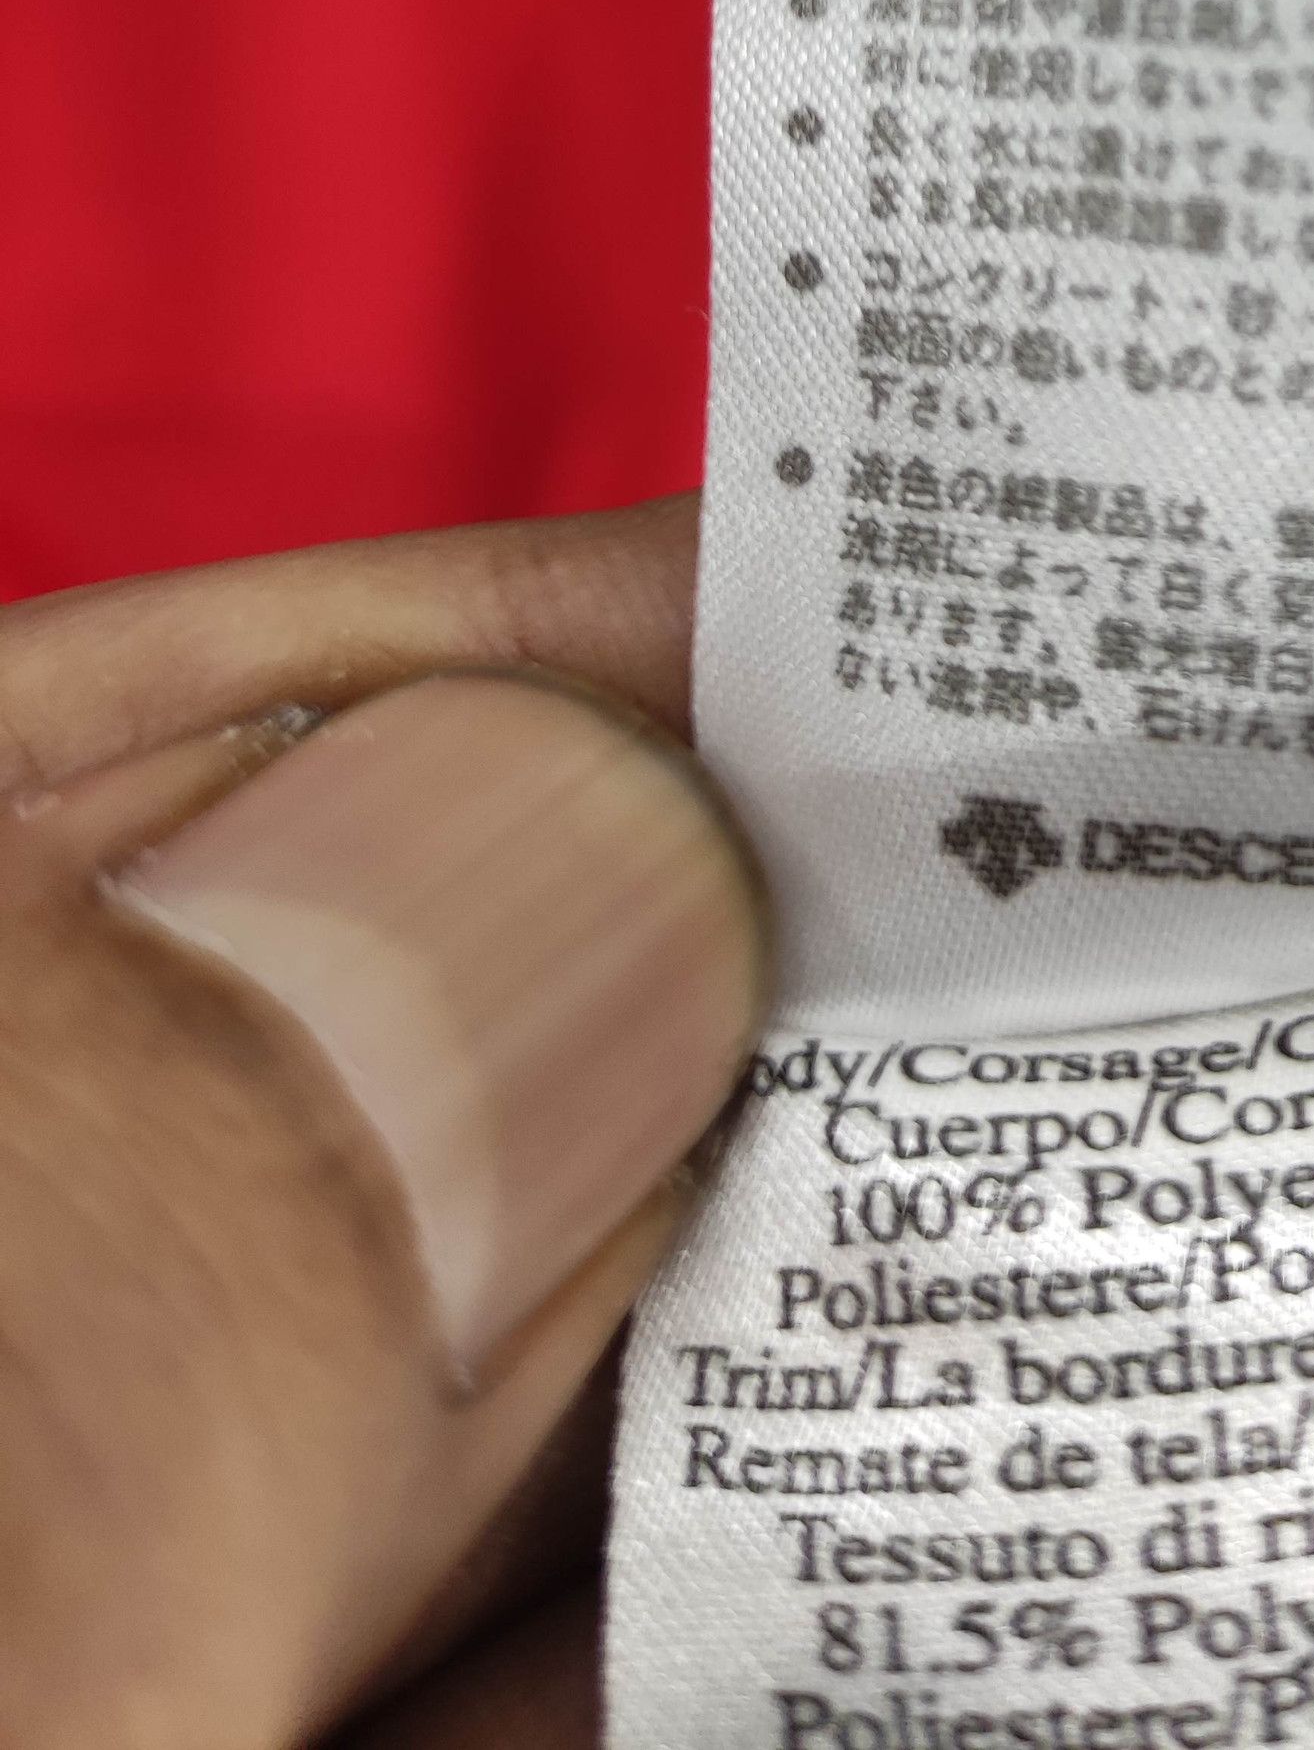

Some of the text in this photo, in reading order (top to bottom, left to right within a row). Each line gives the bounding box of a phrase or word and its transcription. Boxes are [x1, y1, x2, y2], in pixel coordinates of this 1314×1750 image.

[859, 368, 1026, 446] 下さい。
[829, 1169, 1046, 1246] 100%
[677, 1338, 976, 1410] Trim/La
[682, 1423, 974, 1496] Remate
[997, 1422, 1100, 1493] de
[778, 1512, 1110, 1584] Tessuto
[1138, 1499, 1226, 1572] di
[817, 1596, 1103, 1674] 81.5%
